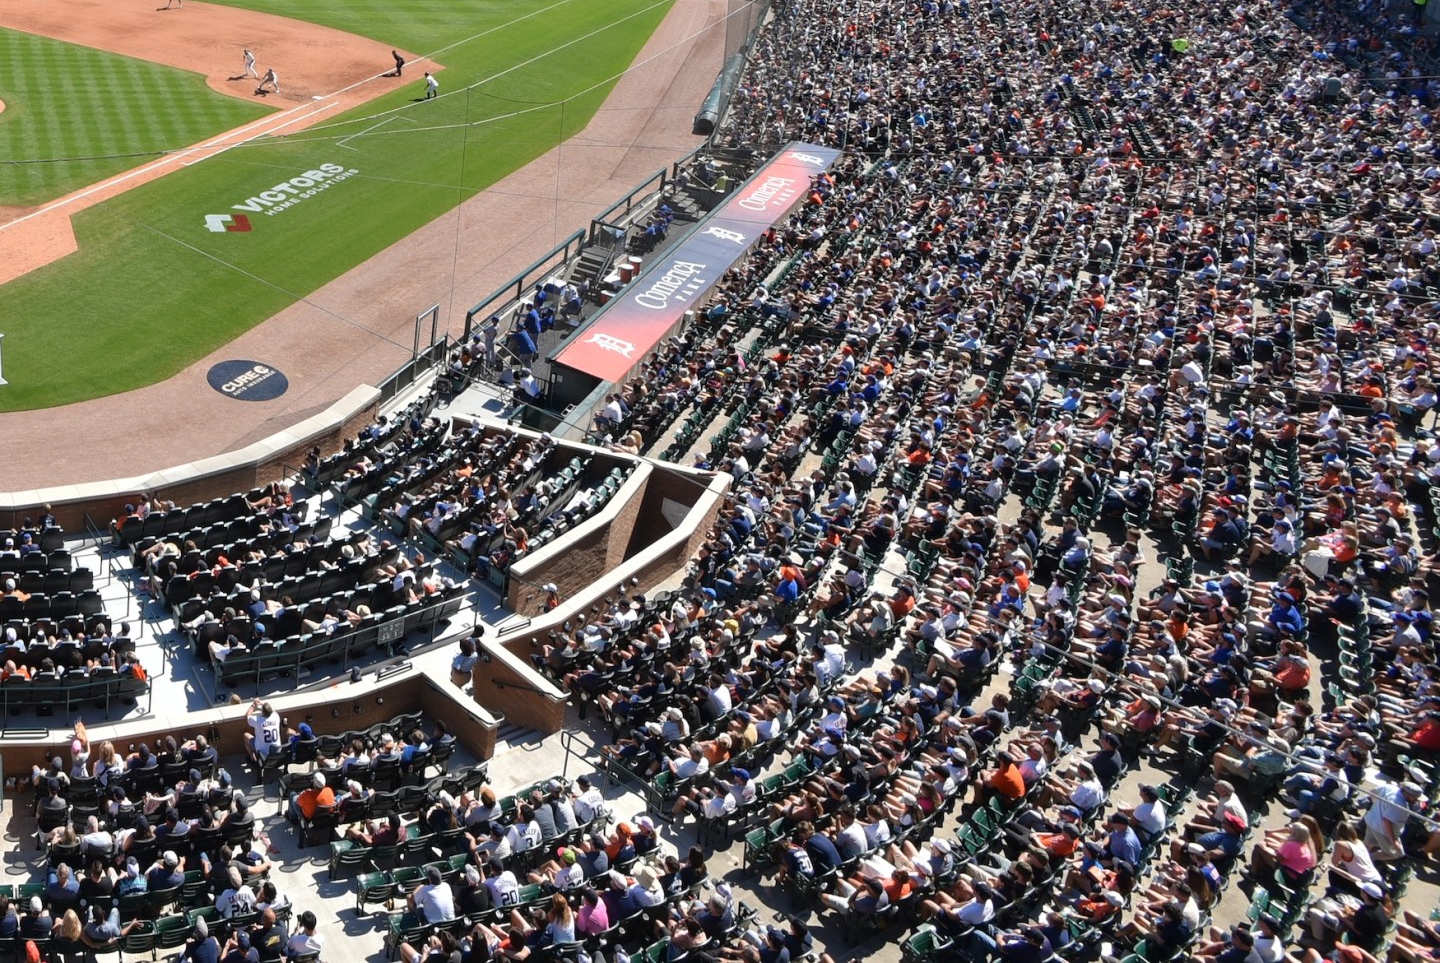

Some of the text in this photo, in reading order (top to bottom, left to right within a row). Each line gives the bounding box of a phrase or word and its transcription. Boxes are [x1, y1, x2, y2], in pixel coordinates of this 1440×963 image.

[231, 163, 344, 212] VICTORS
[264, 169, 359, 216] HOME SOLUTIONS
[772, 189, 796, 206] PARK
[675, 277, 706, 302] PARK
[222, 370, 260, 392] CURE
[263, 729, 278, 743] 20
[501, 890, 518, 905] 20
[232, 902, 249, 916] 24
